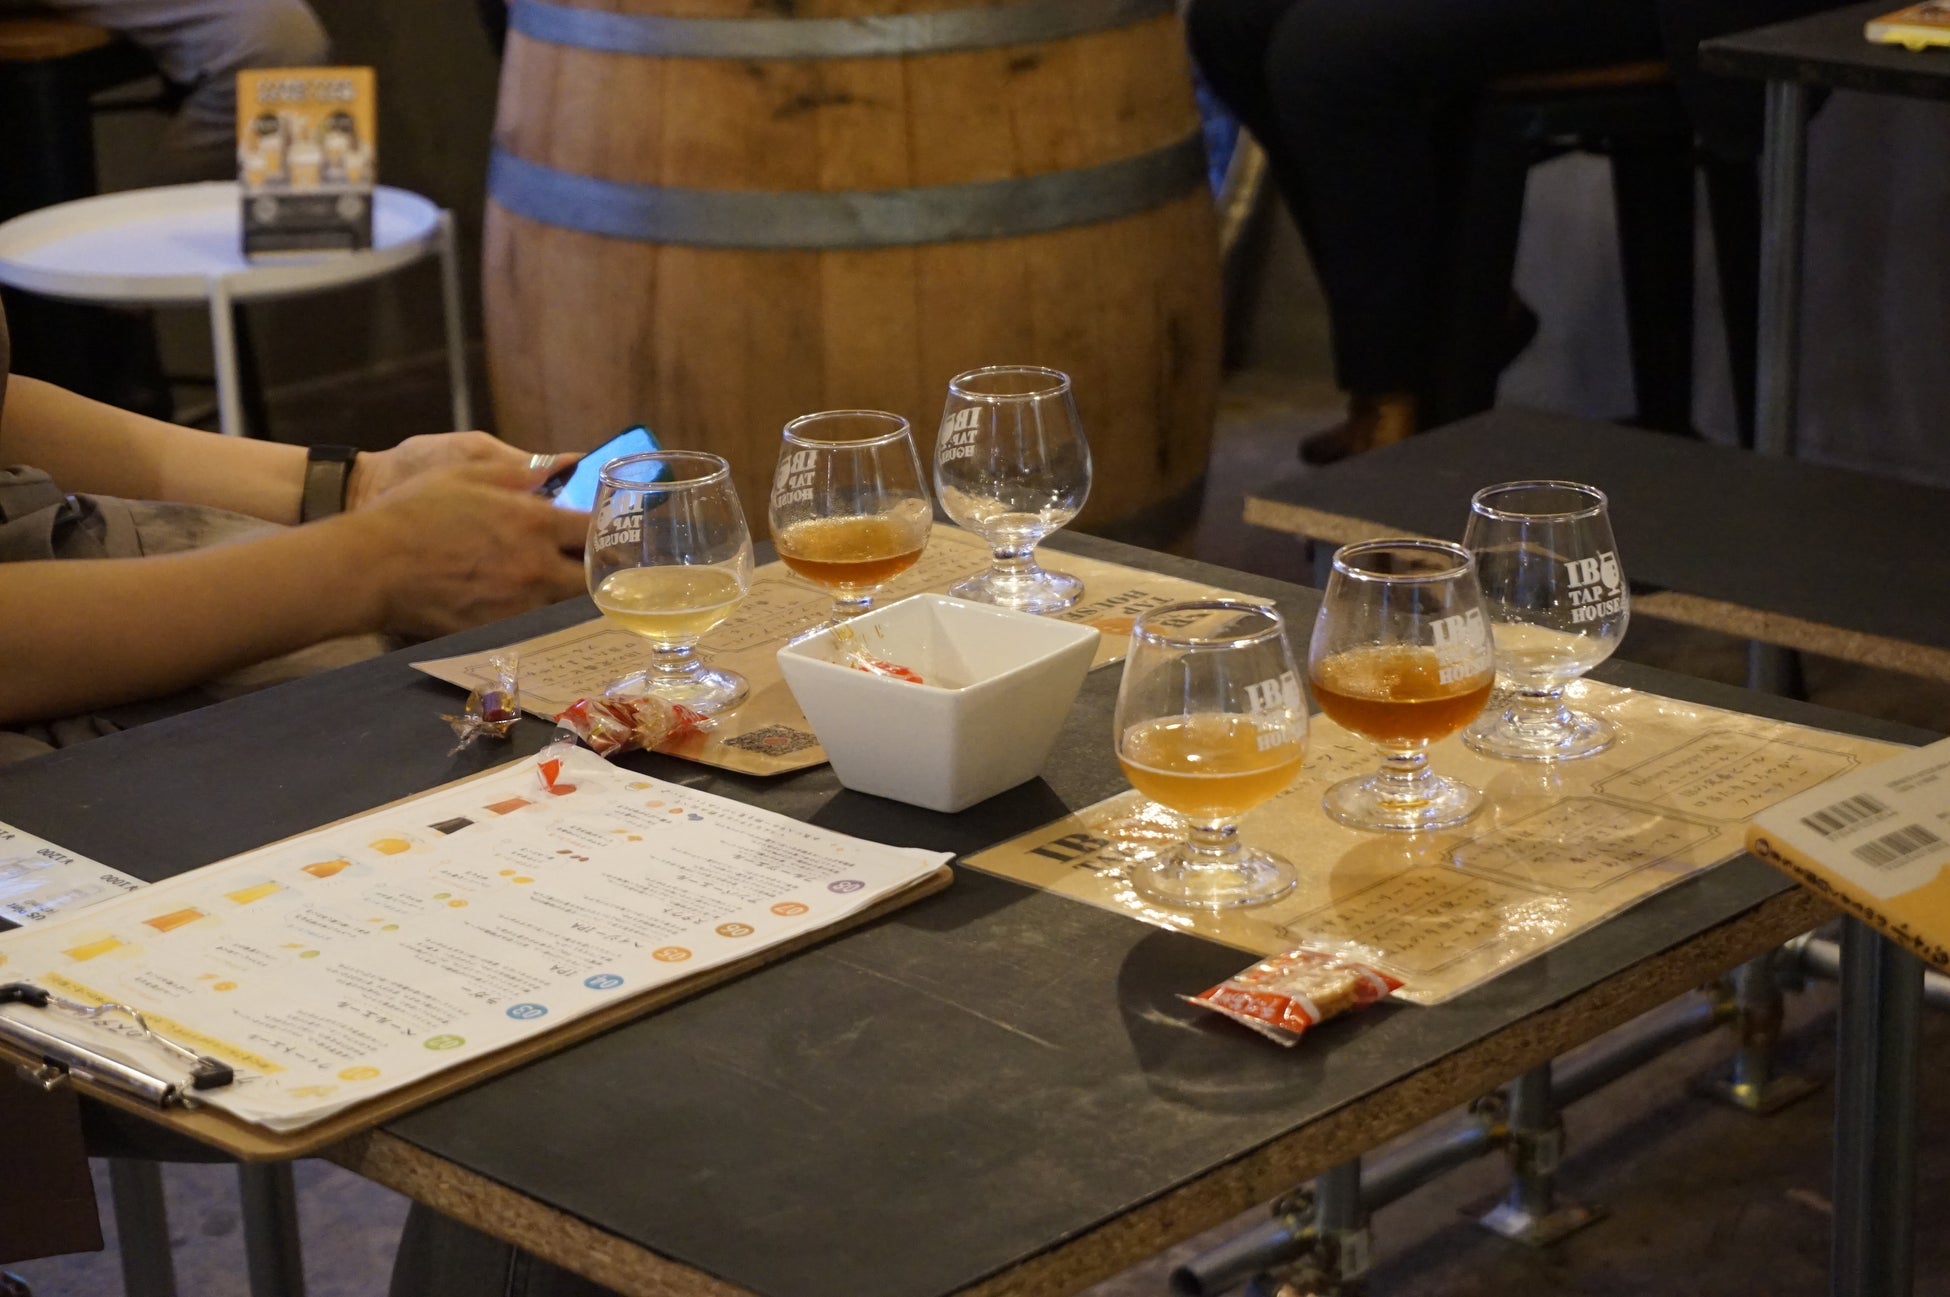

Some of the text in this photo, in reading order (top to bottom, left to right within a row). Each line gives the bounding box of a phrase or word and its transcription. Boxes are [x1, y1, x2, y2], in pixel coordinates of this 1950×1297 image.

[1568, 586, 1602, 606] TAP
[1571, 598, 1620, 623] HOUSE
[550, 964, 580, 978] IPA
